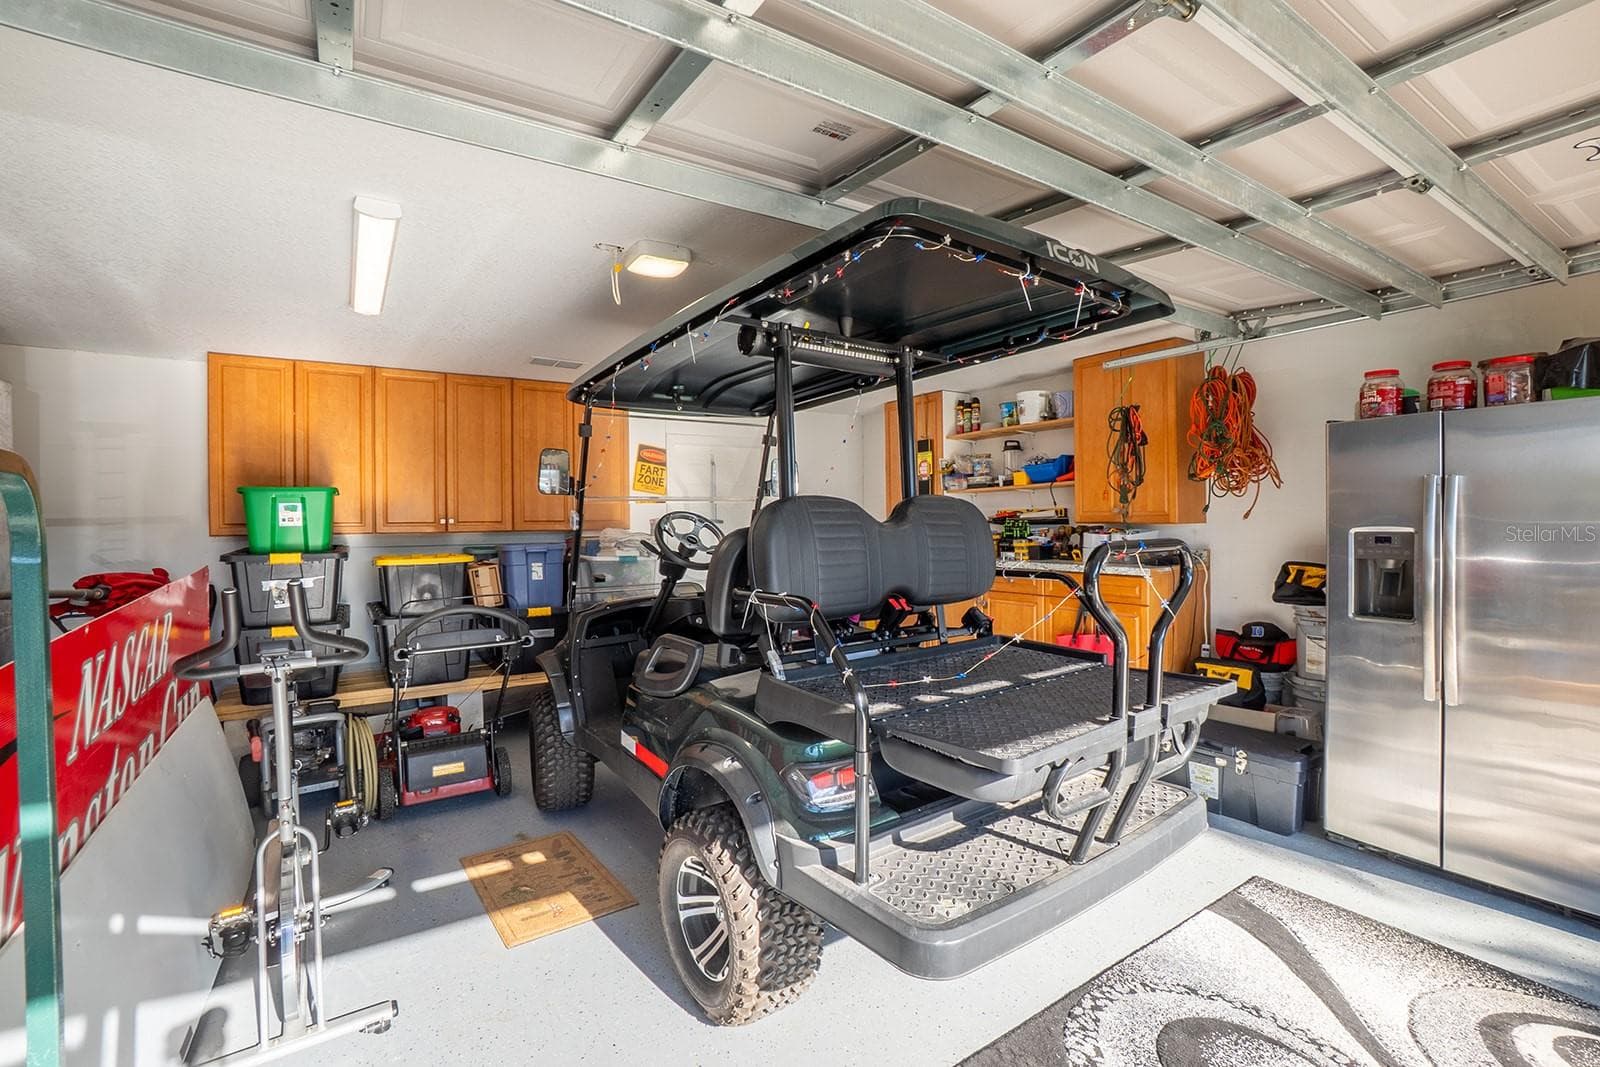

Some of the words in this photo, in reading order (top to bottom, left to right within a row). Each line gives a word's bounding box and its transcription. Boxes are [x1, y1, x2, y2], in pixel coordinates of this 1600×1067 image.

[1046, 240, 1099, 274] ICON
[637, 473, 665, 488] ZONE
[640, 464, 666, 478] FART
[66, 609, 173, 766] NASCAR
